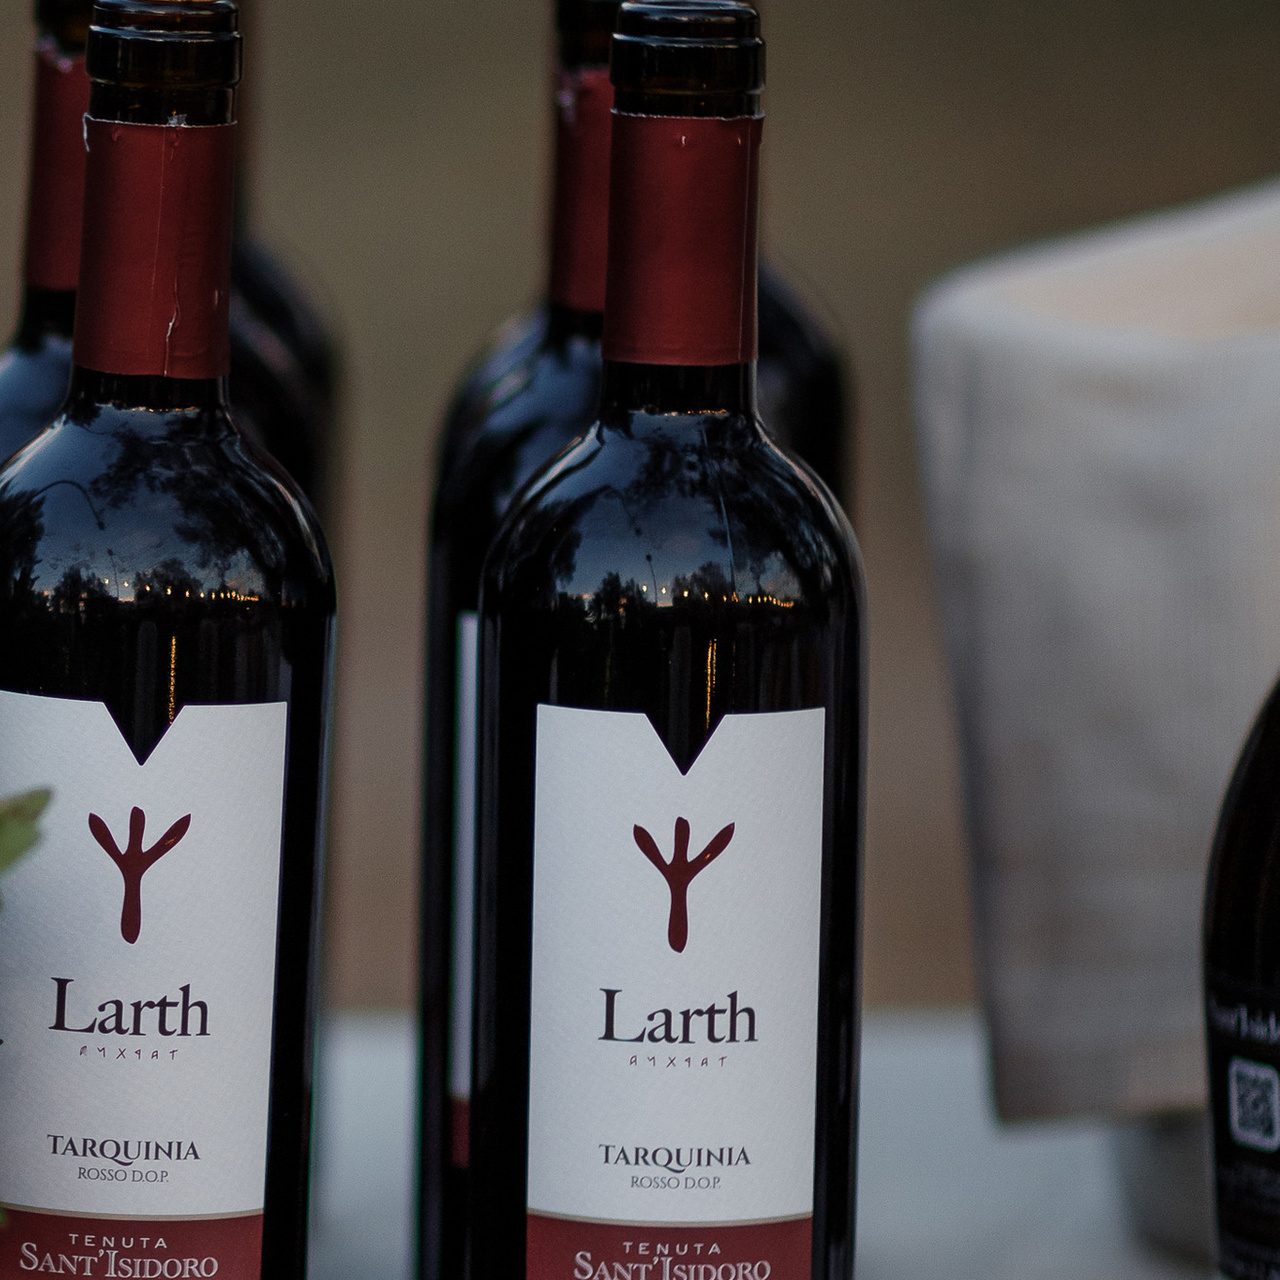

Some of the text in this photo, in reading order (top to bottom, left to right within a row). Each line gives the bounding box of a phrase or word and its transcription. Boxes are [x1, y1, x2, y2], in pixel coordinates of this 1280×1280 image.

[48, 976, 211, 1037] Larth
[598, 987, 759, 1044] Larth
[46, 1134, 201, 1167] TARQUINIA
[598, 1143, 751, 1174] TARQUINIA
[77, 1166, 169, 1183] ROSSO D.O.P.
[630, 1174, 681, 1190] ROSSO
[68, 1233, 168, 1249] TENUTA
[622, 1240, 722, 1256] TENUTA
